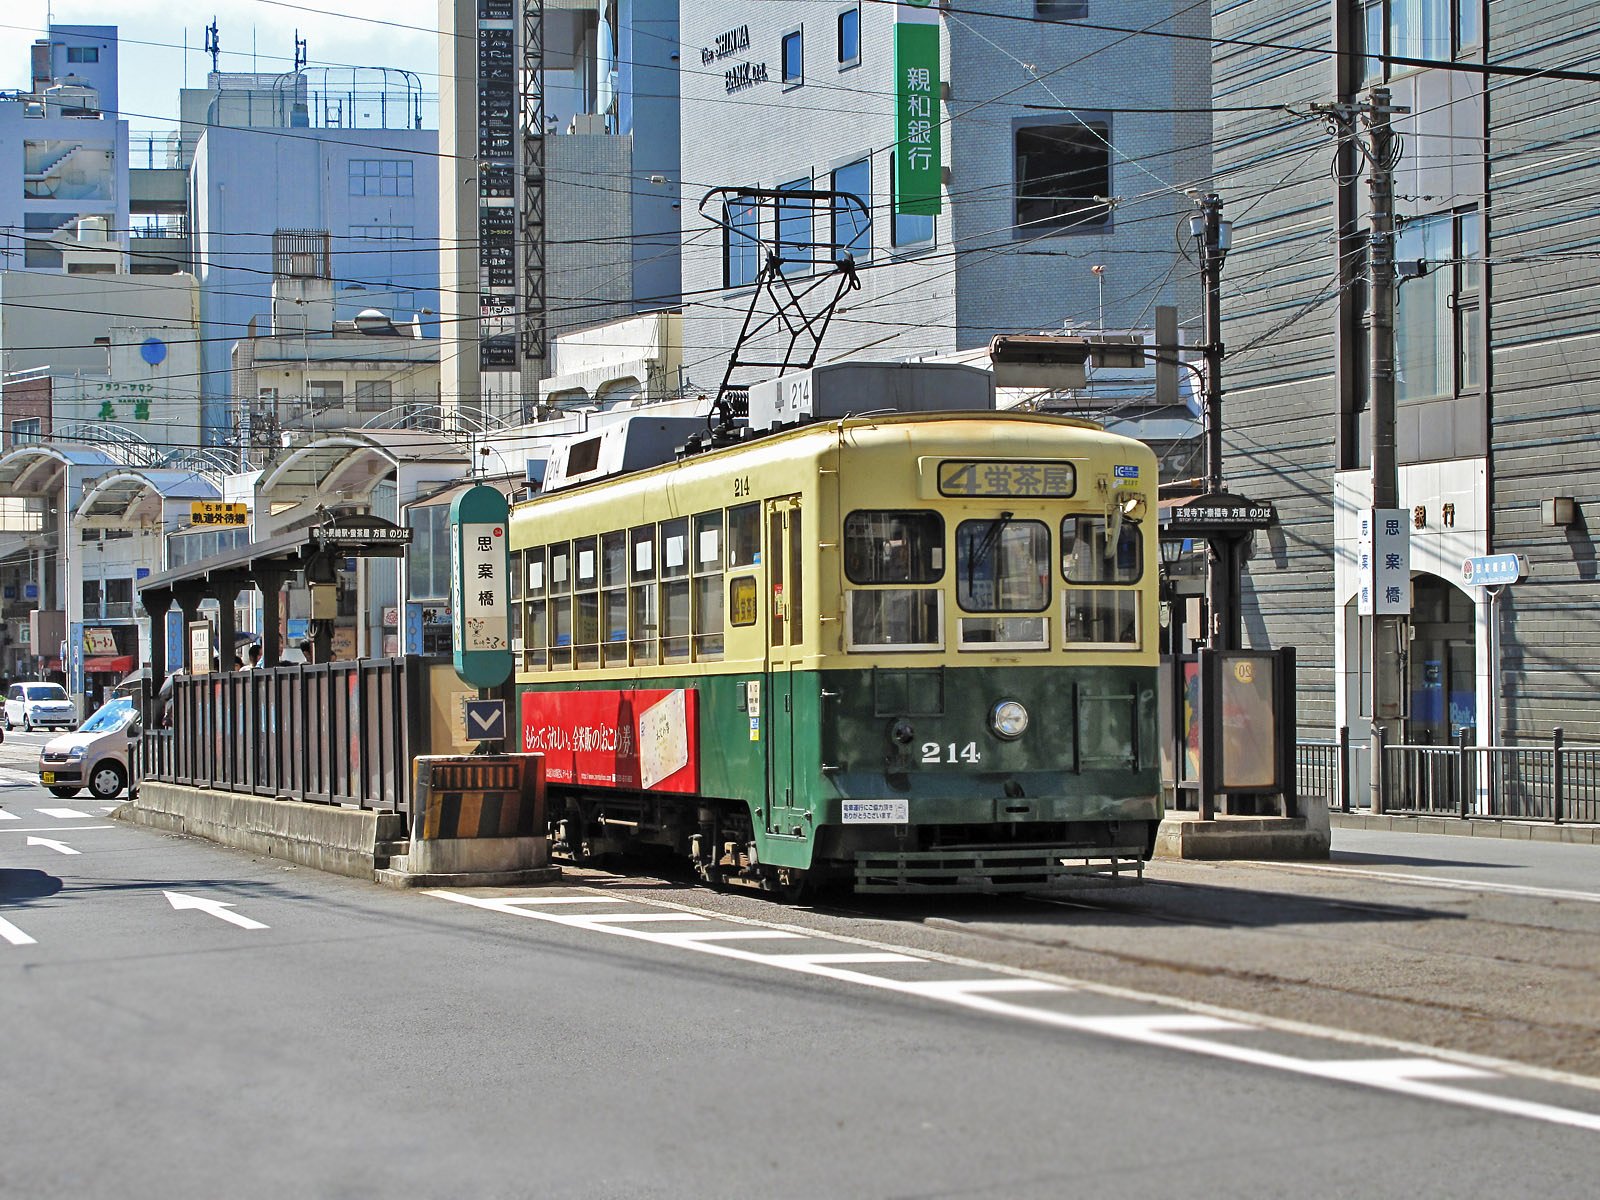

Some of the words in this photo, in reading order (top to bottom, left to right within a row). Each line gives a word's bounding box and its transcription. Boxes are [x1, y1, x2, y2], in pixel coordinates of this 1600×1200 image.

[715, 24, 749, 57] SHINWA
[908, 67, 931, 170] 親和銀行
[791, 379, 811, 409] 214
[734, 475, 750, 497] 214
[942, 463, 982, 495] 4
[984, 465, 1069, 495] 蛍茶屋
[1232, 508, 1246, 518] 方面
[1249, 508, 1271, 518] のりば
[1413, 503, 1455, 530] 銀行
[373, 528, 386, 538] 方面
[389, 529, 409, 538] のりば
[477, 536, 494, 606] 思案橋
[1385, 519, 1400, 603] 思案橋
[921, 741, 981, 763] 214
